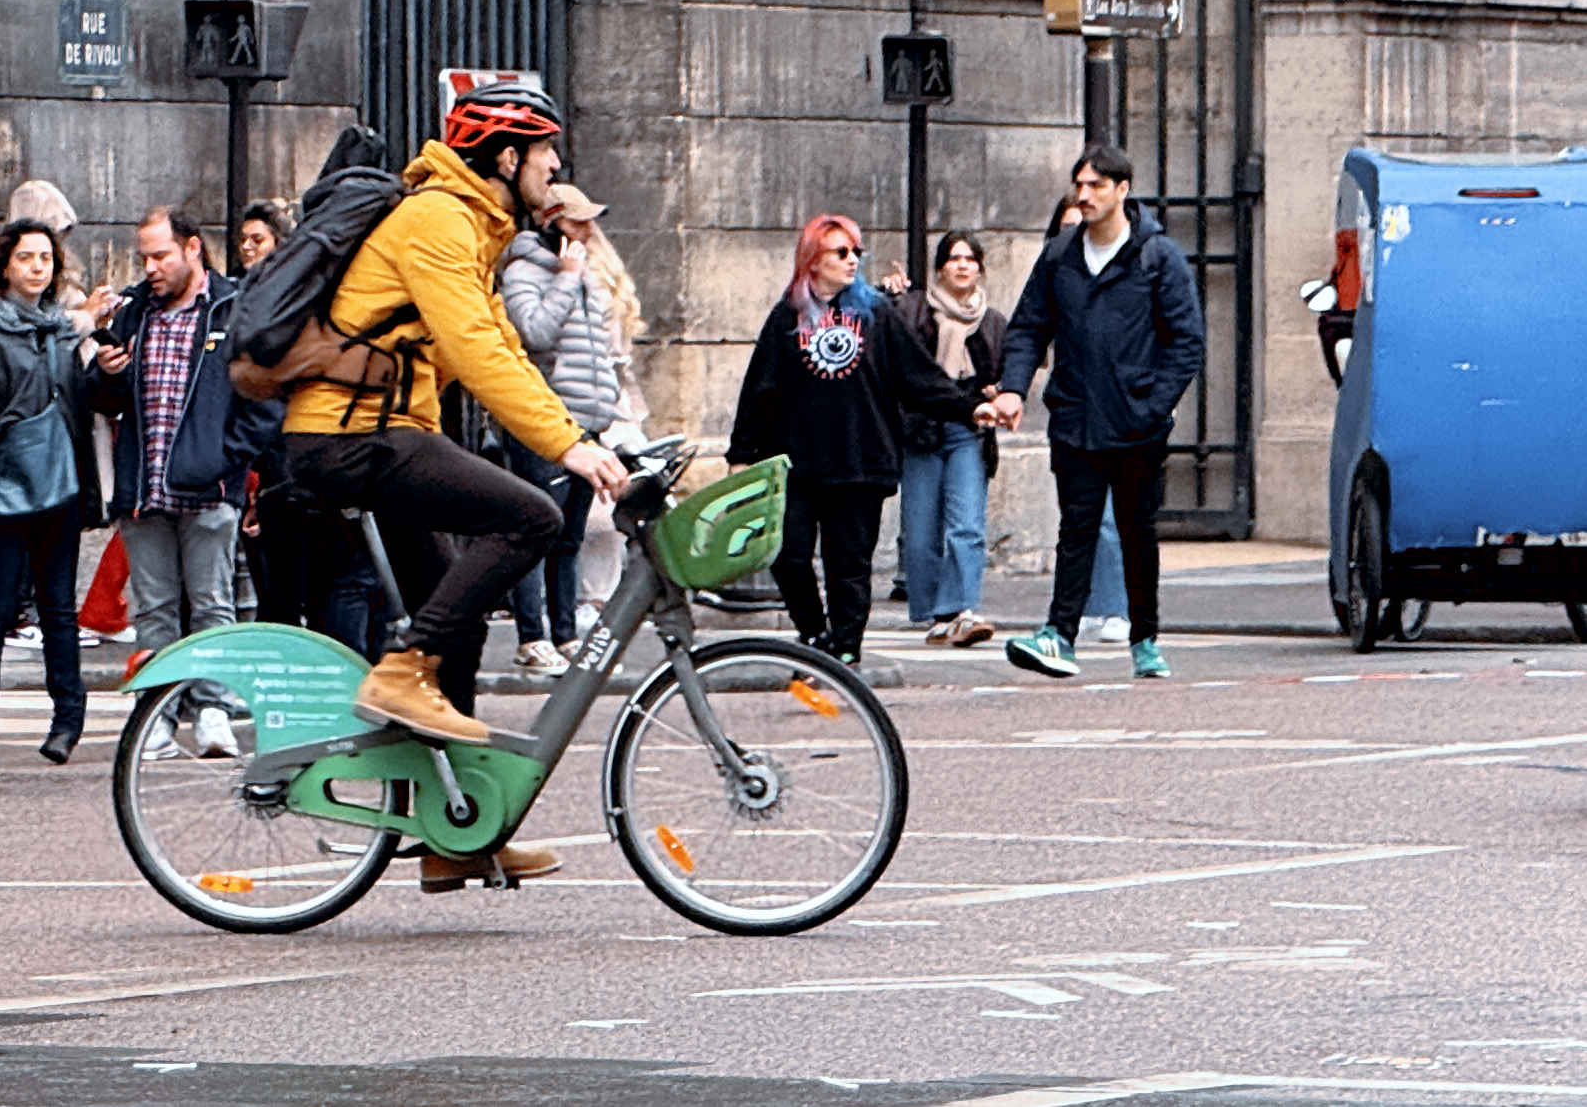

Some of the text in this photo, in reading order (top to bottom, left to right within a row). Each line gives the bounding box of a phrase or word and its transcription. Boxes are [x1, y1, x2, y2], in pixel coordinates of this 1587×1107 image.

[82, 12, 106, 35] RUE
[65, 42, 122, 66] DE RIVOLI
